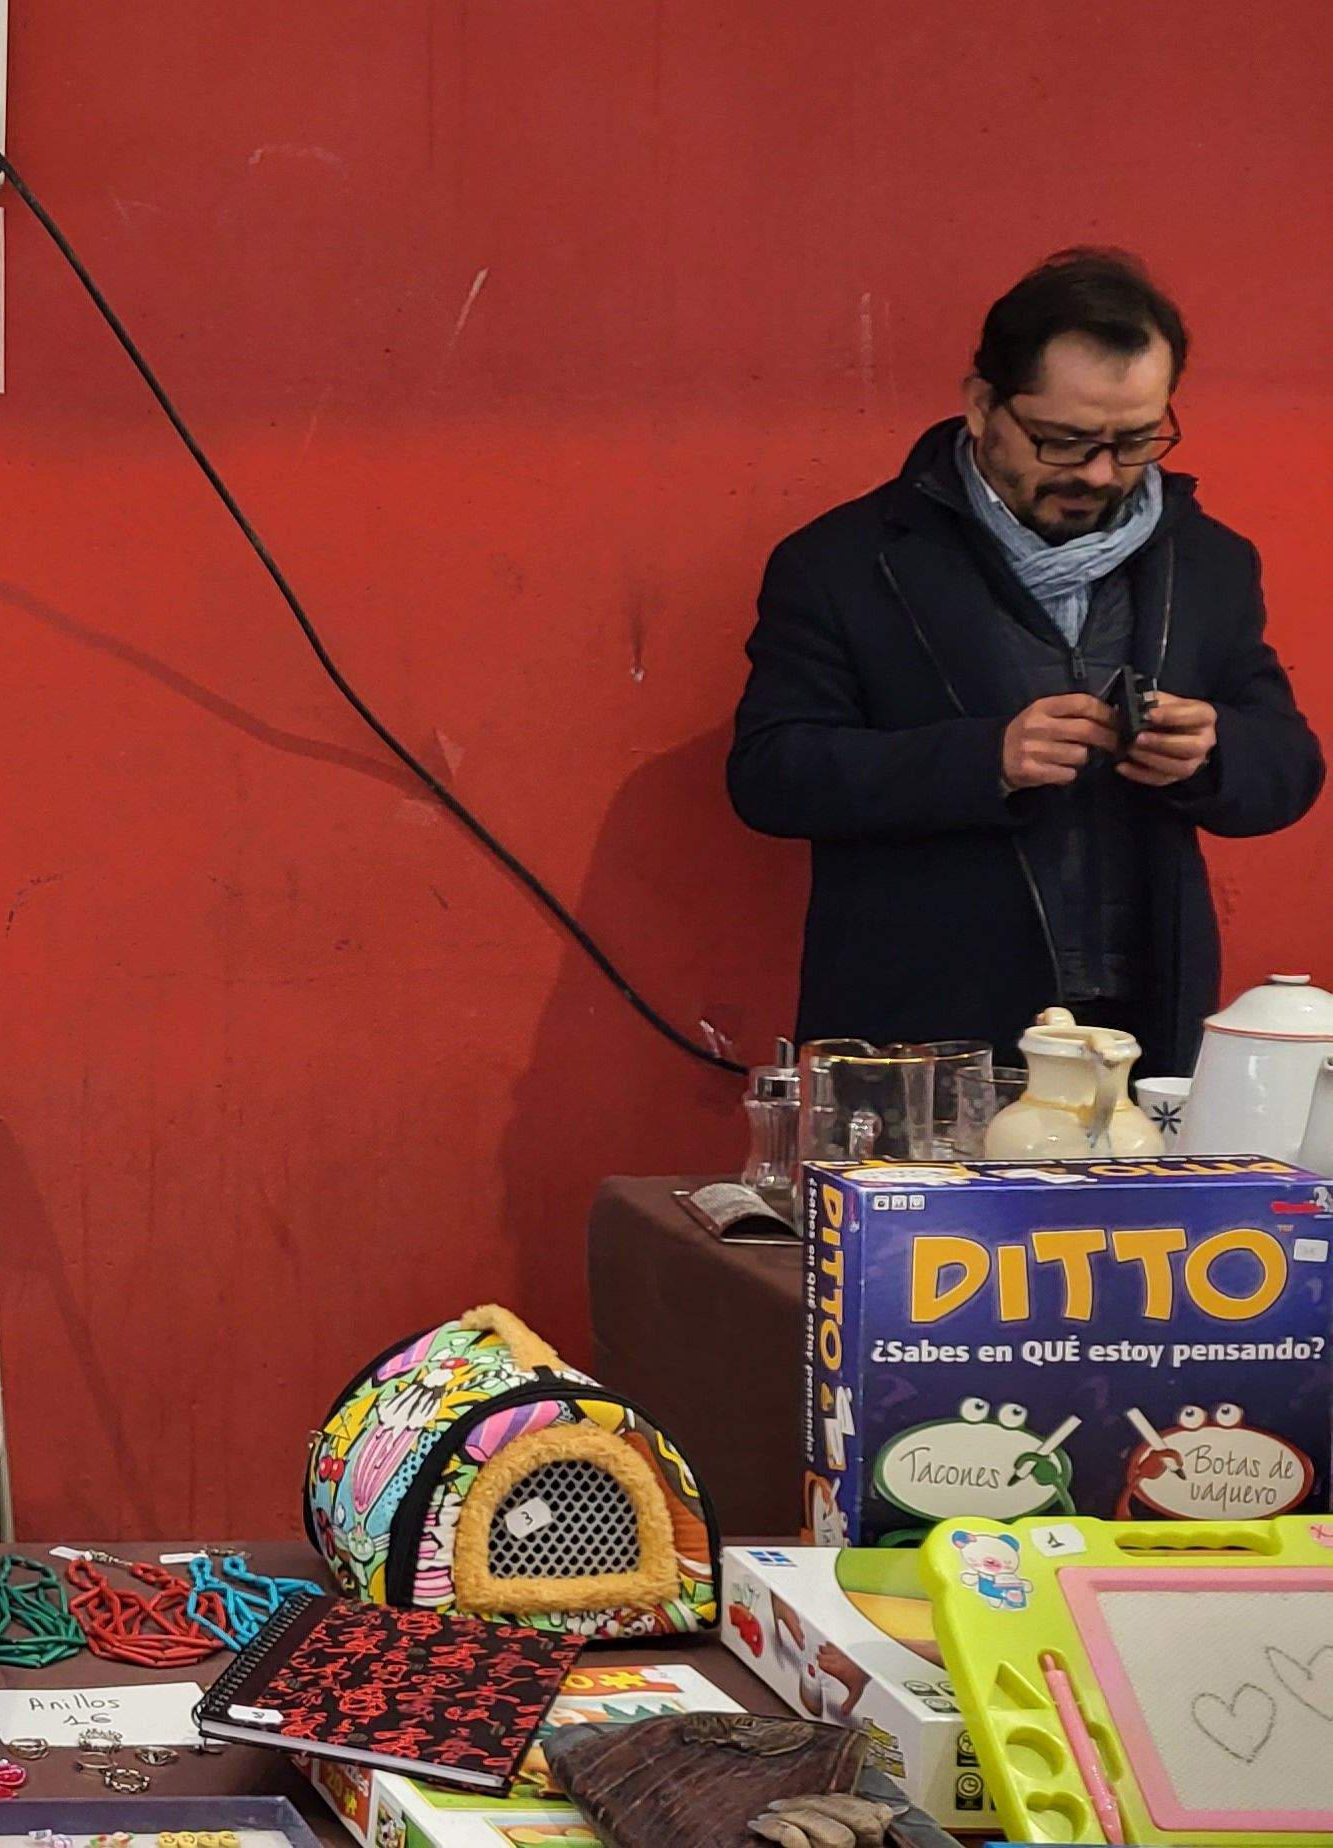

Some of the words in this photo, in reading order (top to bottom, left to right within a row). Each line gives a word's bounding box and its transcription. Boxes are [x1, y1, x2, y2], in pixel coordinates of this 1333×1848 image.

[820, 1183, 844, 1371] DITTO
[910, 1228, 1289, 1323] DITTO
[871, 1339, 970, 1363] ¿Sabes
[978, 1347, 1013, 1362] en
[1022, 1335, 1081, 1367] QUÉ
[1089, 1346, 1162, 1368] estoy
[1172, 1337, 1325, 1368] pensando?
[900, 1446, 1000, 1490] Tacones
[1185, 1444, 1260, 1477] Botas
[1268, 1451, 1294, 1479] de
[1190, 1482, 1277, 1512] vaquero
[521, 1511, 533, 1526] 3
[30, 1693, 121, 1711] Anillos
